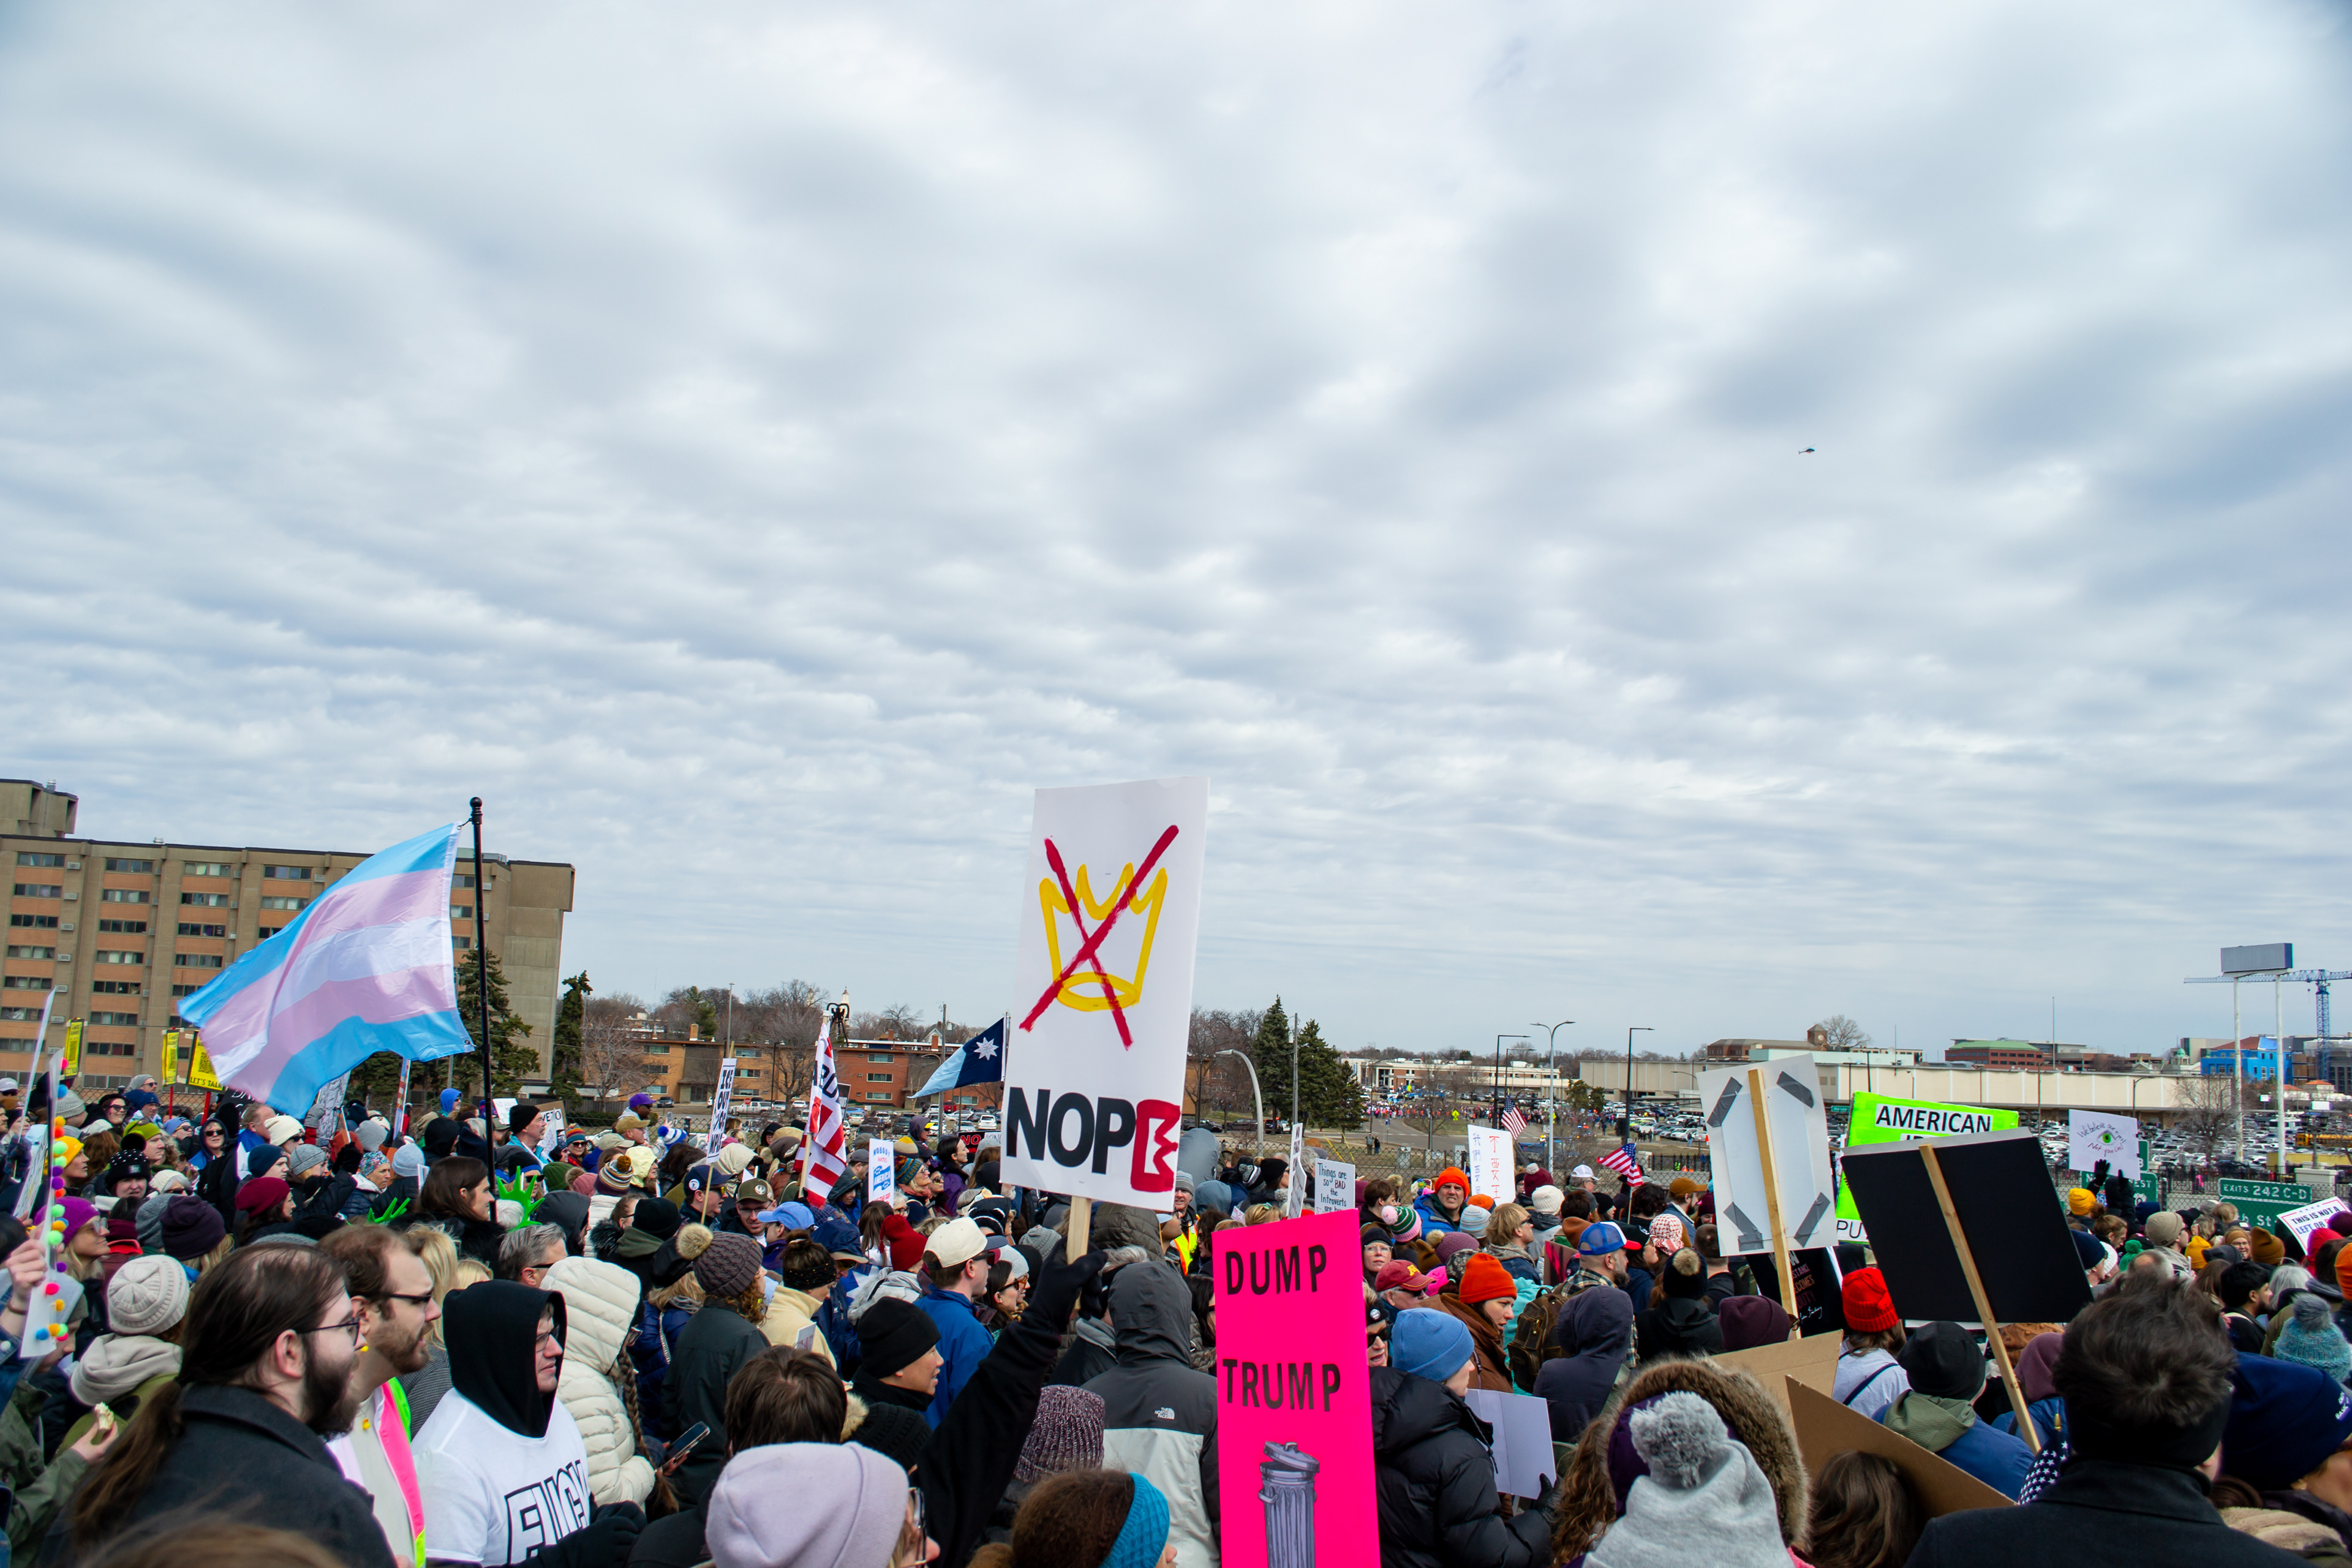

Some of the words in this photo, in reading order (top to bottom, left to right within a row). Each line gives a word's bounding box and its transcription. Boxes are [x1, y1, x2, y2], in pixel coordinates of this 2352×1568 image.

[190, 1077, 206, 1085] LET'S
[720, 1069, 734, 1090] ICE
[717, 1091, 730, 1110] OUT
[541, 1110, 562, 1123] VEO
[1876, 1106, 1992, 1133] AMERICAN
[2076, 1125, 2089, 1137] We
[960, 1134, 981, 1145] NO
[2087, 1142, 2102, 1152] Not
[1317, 1163, 1336, 1183] Things
[1338, 1171, 1347, 1180] are
[1335, 1180, 1346, 1189] BAD
[1330, 1188, 1338, 1196] the
[2223, 1184, 2249, 1193] EXITS
[2253, 1185, 2280, 1197] 242
[2283, 1187, 2307, 1200] C-D
[1321, 1194, 1347, 1207] Introverts
[2256, 1215, 2272, 1227] St
[2291, 1214, 2310, 1224] THIS
[2310, 1210, 2319, 1219] IS
[2318, 1206, 2334, 1218] NOT
[2296, 1223, 2313, 1234] LEFT
[1226, 1245, 1327, 1295] DUMP
[1794, 1274, 1815, 1294] ECOMES
[1223, 1359, 1341, 1412] TRUMP
